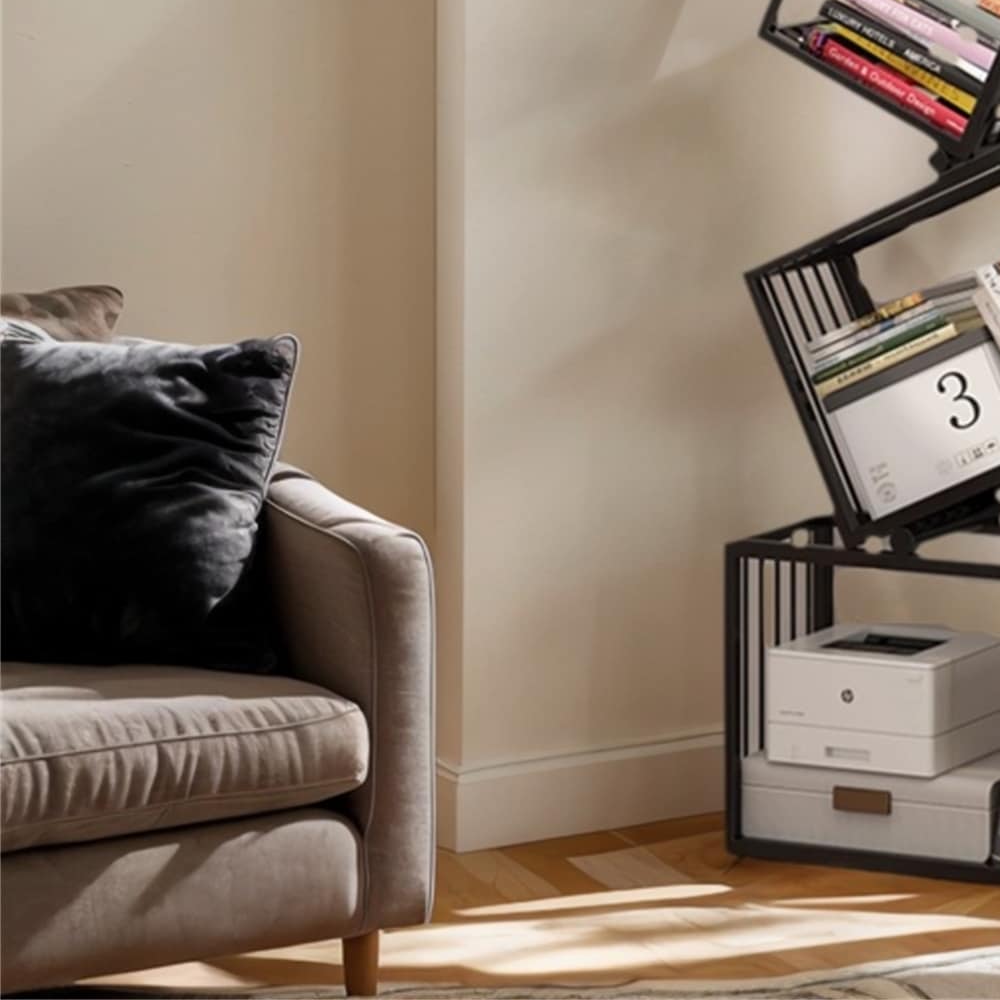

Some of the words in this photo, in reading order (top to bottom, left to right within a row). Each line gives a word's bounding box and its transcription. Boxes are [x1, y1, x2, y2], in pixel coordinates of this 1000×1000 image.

[827, 6, 862, 32] LUXURY
[861, 23, 896, 49] HOTELS
[903, 47, 942, 73] AMERICA
[827, 46, 861, 71] Garden
[868, 70, 906, 98] Outdoor
[905, 92, 937, 117] Design
[937, 371, 980, 429] 3
